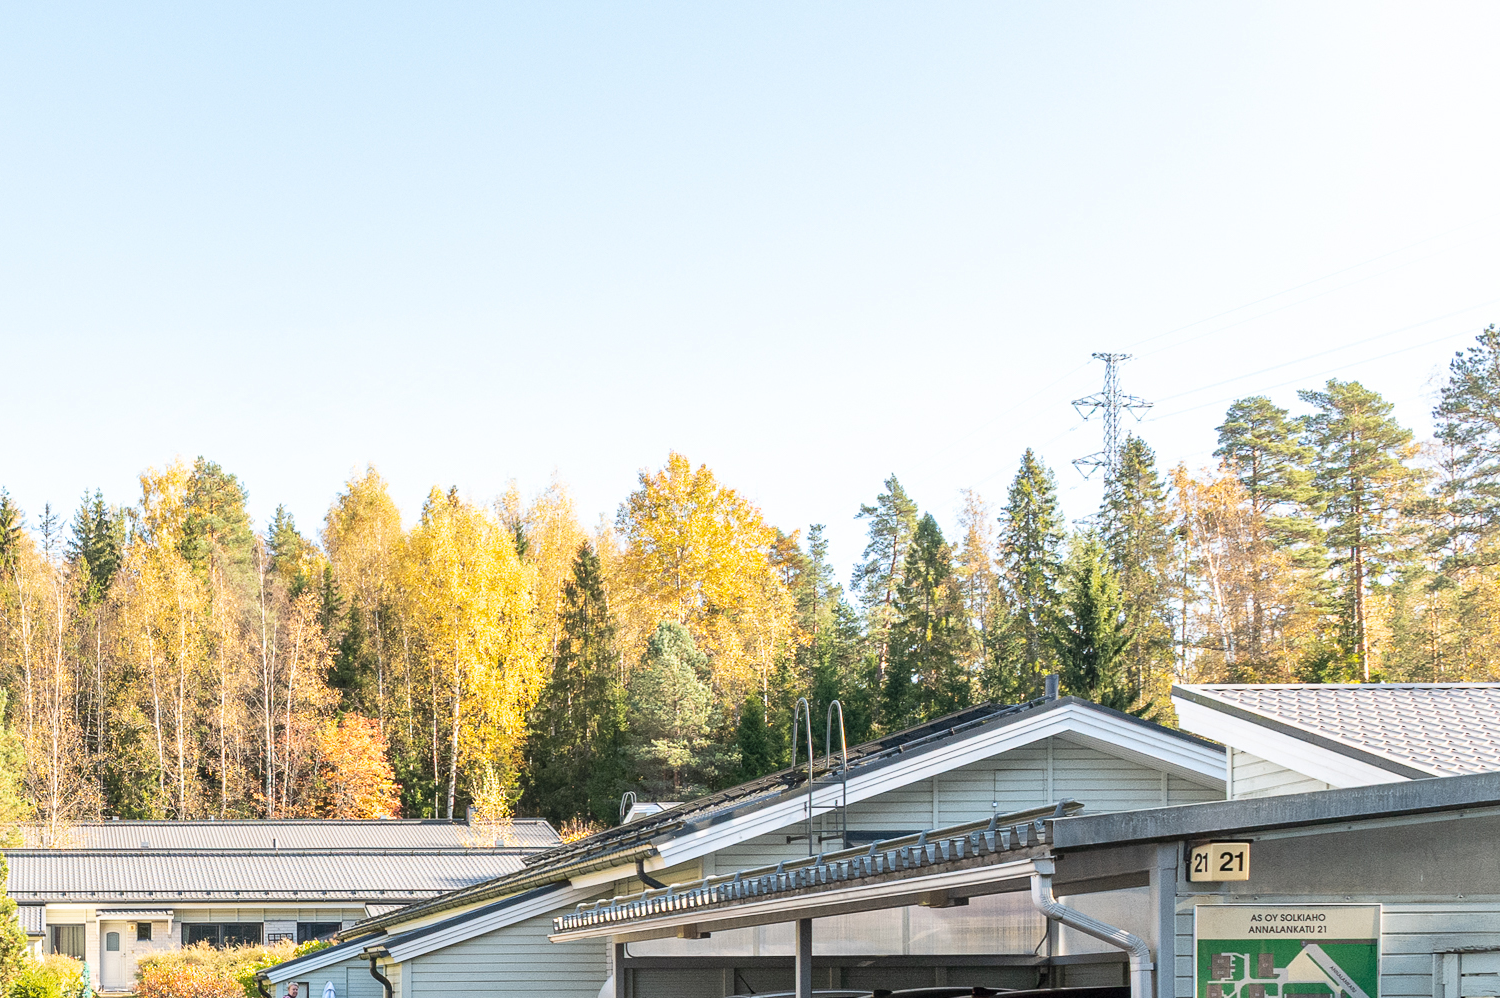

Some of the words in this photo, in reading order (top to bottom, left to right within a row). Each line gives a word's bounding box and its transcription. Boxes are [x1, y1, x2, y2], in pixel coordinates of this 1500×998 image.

[1194, 852, 1208, 873] 21
[1219, 851, 1244, 872] 21
[1250, 914, 1263, 922] AS
[1264, 913, 1279, 922] OY
[1280, 913, 1326, 922] SOLKIAHO
[1248, 925, 1316, 934] ANNALANKATU
[1317, 925, 1327, 934] 21
[1330, 965, 1357, 993] ANNALANKATU
